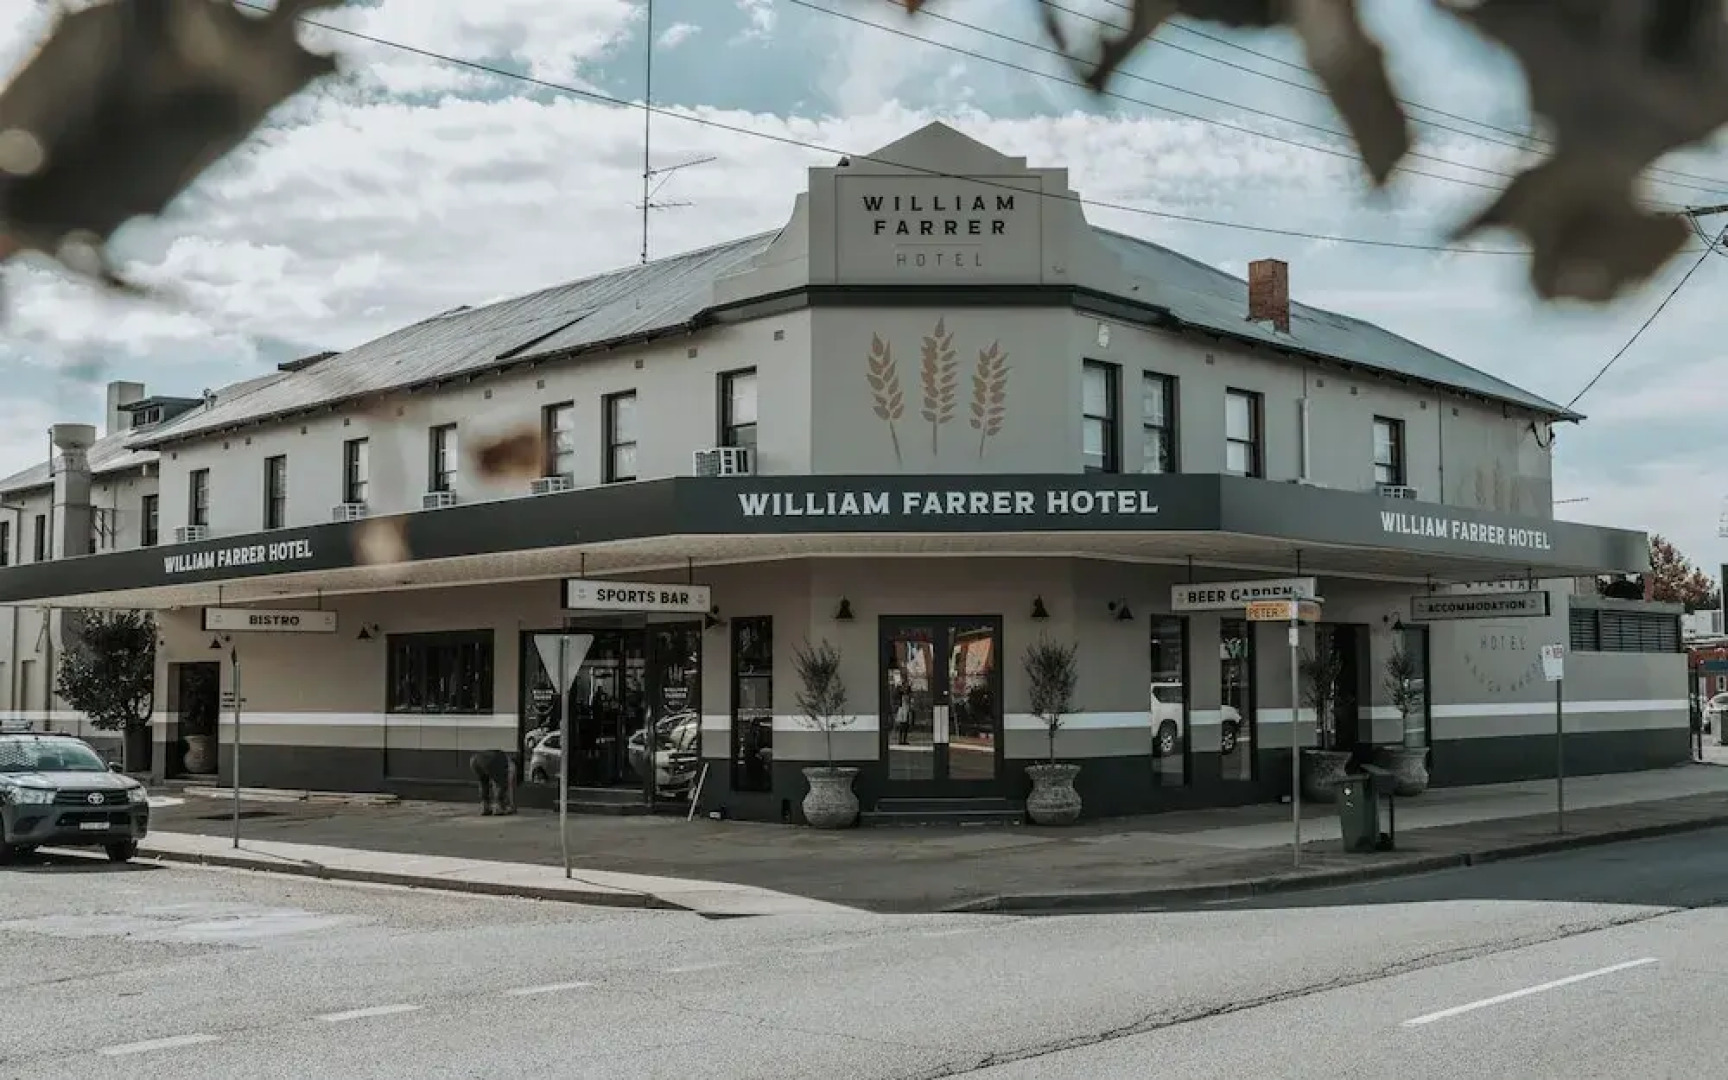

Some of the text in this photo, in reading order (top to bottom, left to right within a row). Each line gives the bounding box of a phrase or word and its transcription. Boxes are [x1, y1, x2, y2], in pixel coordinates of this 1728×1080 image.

[863, 196, 1015, 211] WILLIAM
[874, 220, 1005, 235] FARRER
[896, 253, 983, 267] HOTEL
[738, 489, 1159, 517] WILLIAM FARRER HOTEL
[1380, 511, 1550, 549] WILLIAM FARRER HOTEL
[164, 540, 312, 573] WILLIAM FARRER HOTEL
[597, 589, 689, 605] SPORTS BAR
[1188, 590, 1225, 603] BEER
[1428, 600, 1526, 612] ACCOMMODATION
[249, 615, 300, 626] BISTRO
[1480, 635, 1526, 651] HOTEL
